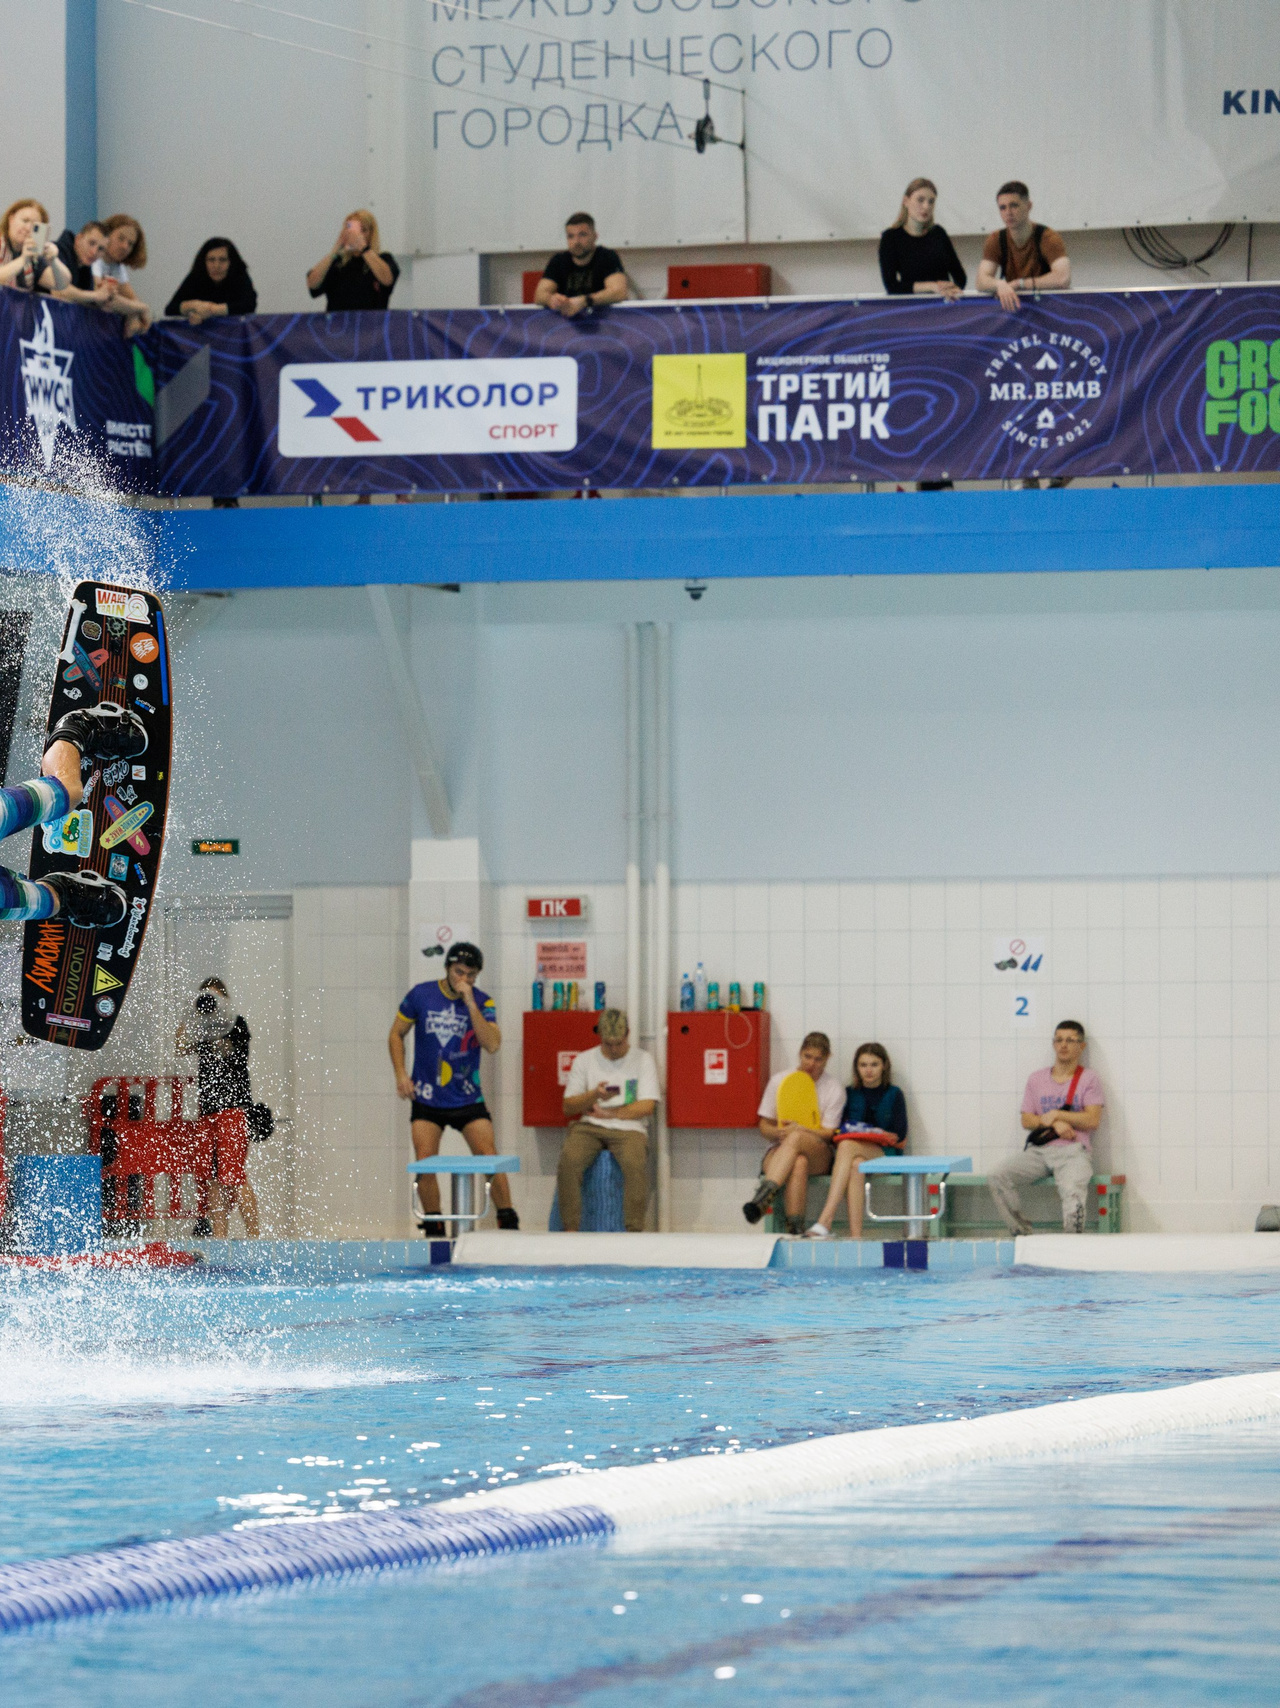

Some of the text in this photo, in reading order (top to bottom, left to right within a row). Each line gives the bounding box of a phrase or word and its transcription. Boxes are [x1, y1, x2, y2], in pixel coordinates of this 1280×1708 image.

[431, 27, 894, 90] СТУДЕНЧЕСКОГО
[432, 101, 685, 153] ГОРОДКА
[985, 332, 1108, 379] TRAVEL ENERGY
[356, 382, 560, 411] ТРИКОЛОР
[756, 364, 891, 401] ТРЕТИЙ
[989, 380, 1102, 401] MR.BEMB
[488, 423, 559, 440] СПОРТ
[757, 402, 890, 442] ПАРК
[1001, 418, 1092, 449] SINCE 2022
[97, 590, 127, 604] WAKE
[540, 900, 568, 916] ПК
[25, 920, 65, 994] HARDWAY
[62, 946, 86, 1014] NOMAD
[1014, 996, 1030, 1016] 2
